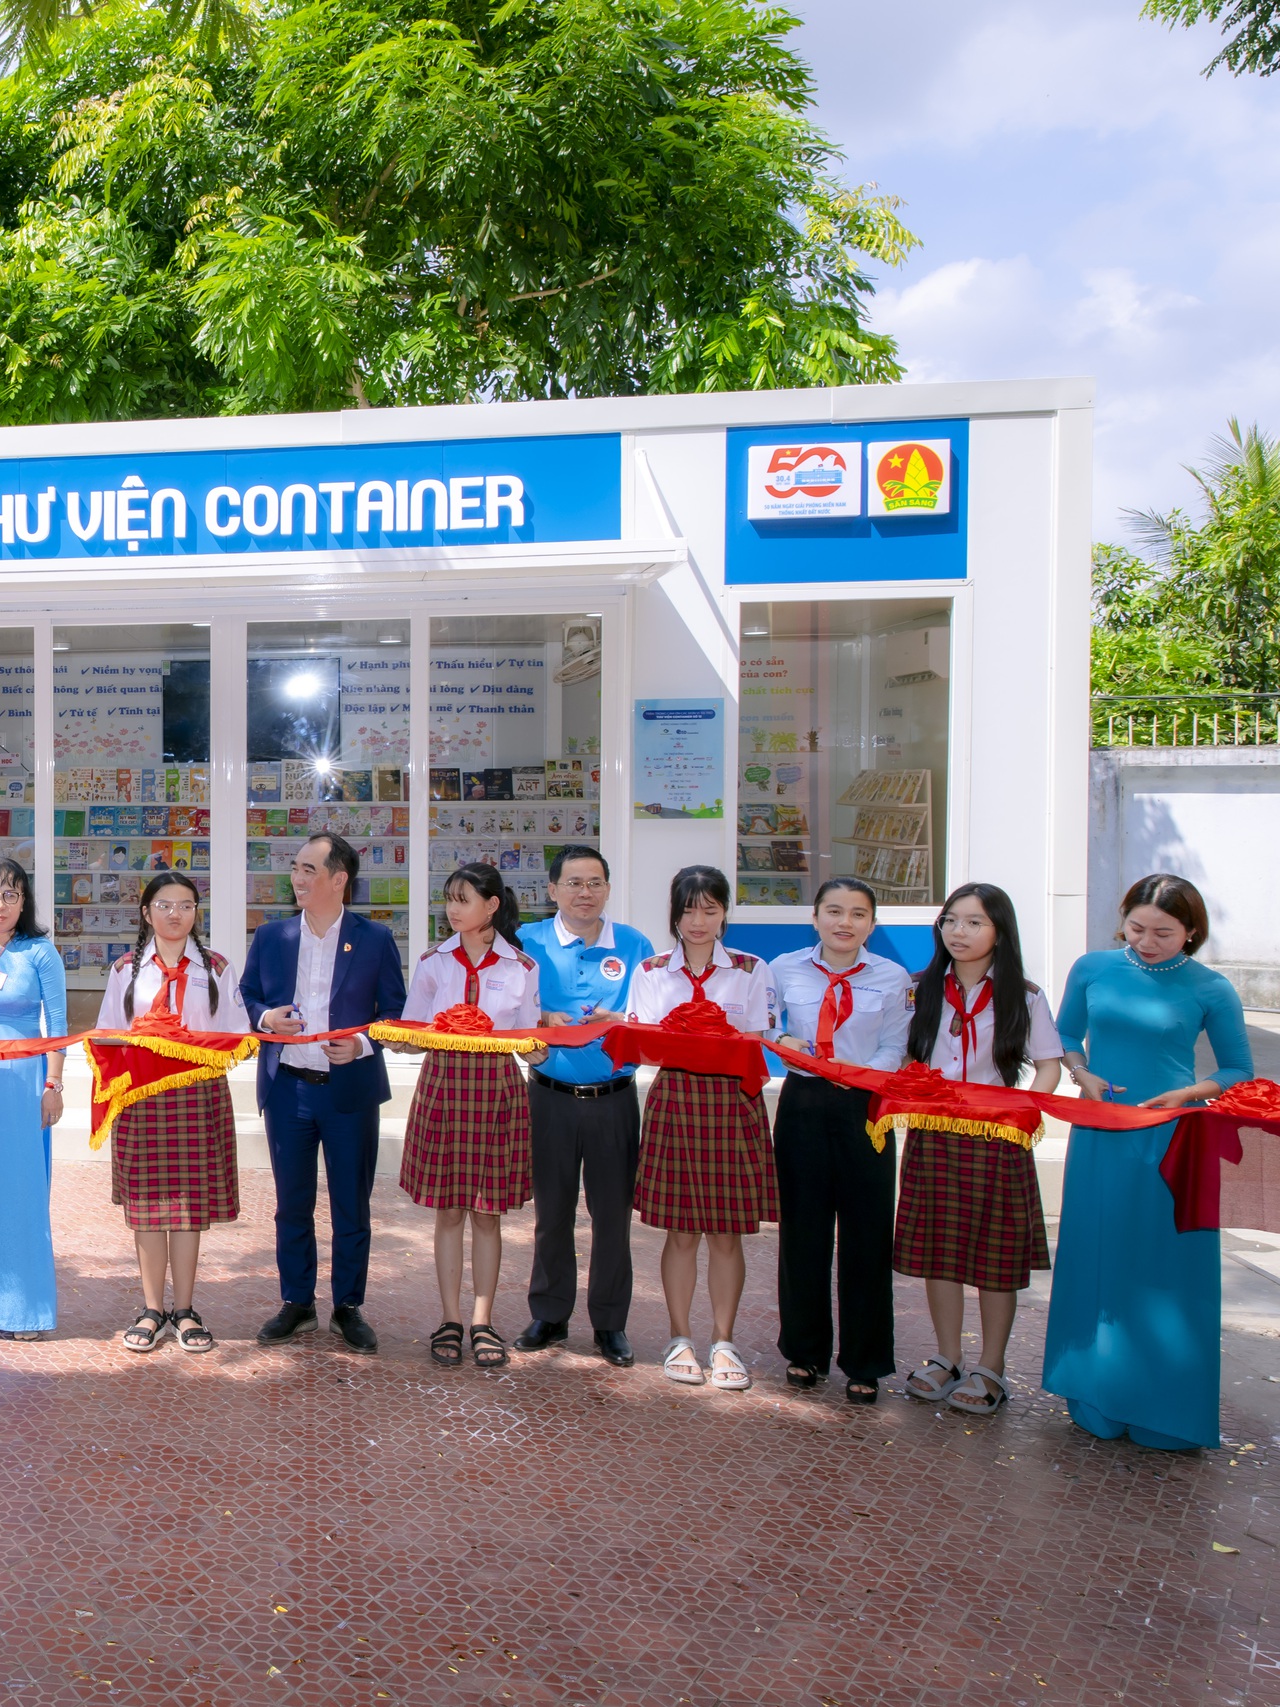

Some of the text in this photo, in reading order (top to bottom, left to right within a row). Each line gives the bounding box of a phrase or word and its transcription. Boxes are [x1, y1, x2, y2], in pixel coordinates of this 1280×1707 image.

[66, 475, 187, 551] VIỆN
[205, 475, 525, 537] CONTAINER
[360, 661, 388, 671] Hạnh
[435, 658, 492, 669] Thấu hiểu
[508, 659, 544, 669] Tự tin
[750, 657, 762, 666] có
[15, 666, 34, 674] thô
[122, 666, 135, 675] hy
[740, 669, 788, 678] của con?
[2, 685, 22, 694] Biết
[53, 685, 79, 695] hông
[96, 684, 117, 694] Biết
[120, 687, 146, 695] quan
[440, 685, 465, 695] lòng
[482, 685, 534, 695] Dịu dàng
[8, 709, 32, 717] Bình
[70, 707, 98, 717] Tử tế
[146, 707, 160, 717] tại
[344, 703, 385, 714] Độc lập
[468, 705, 505, 713] Thanh
[517, 781, 540, 791] ART
